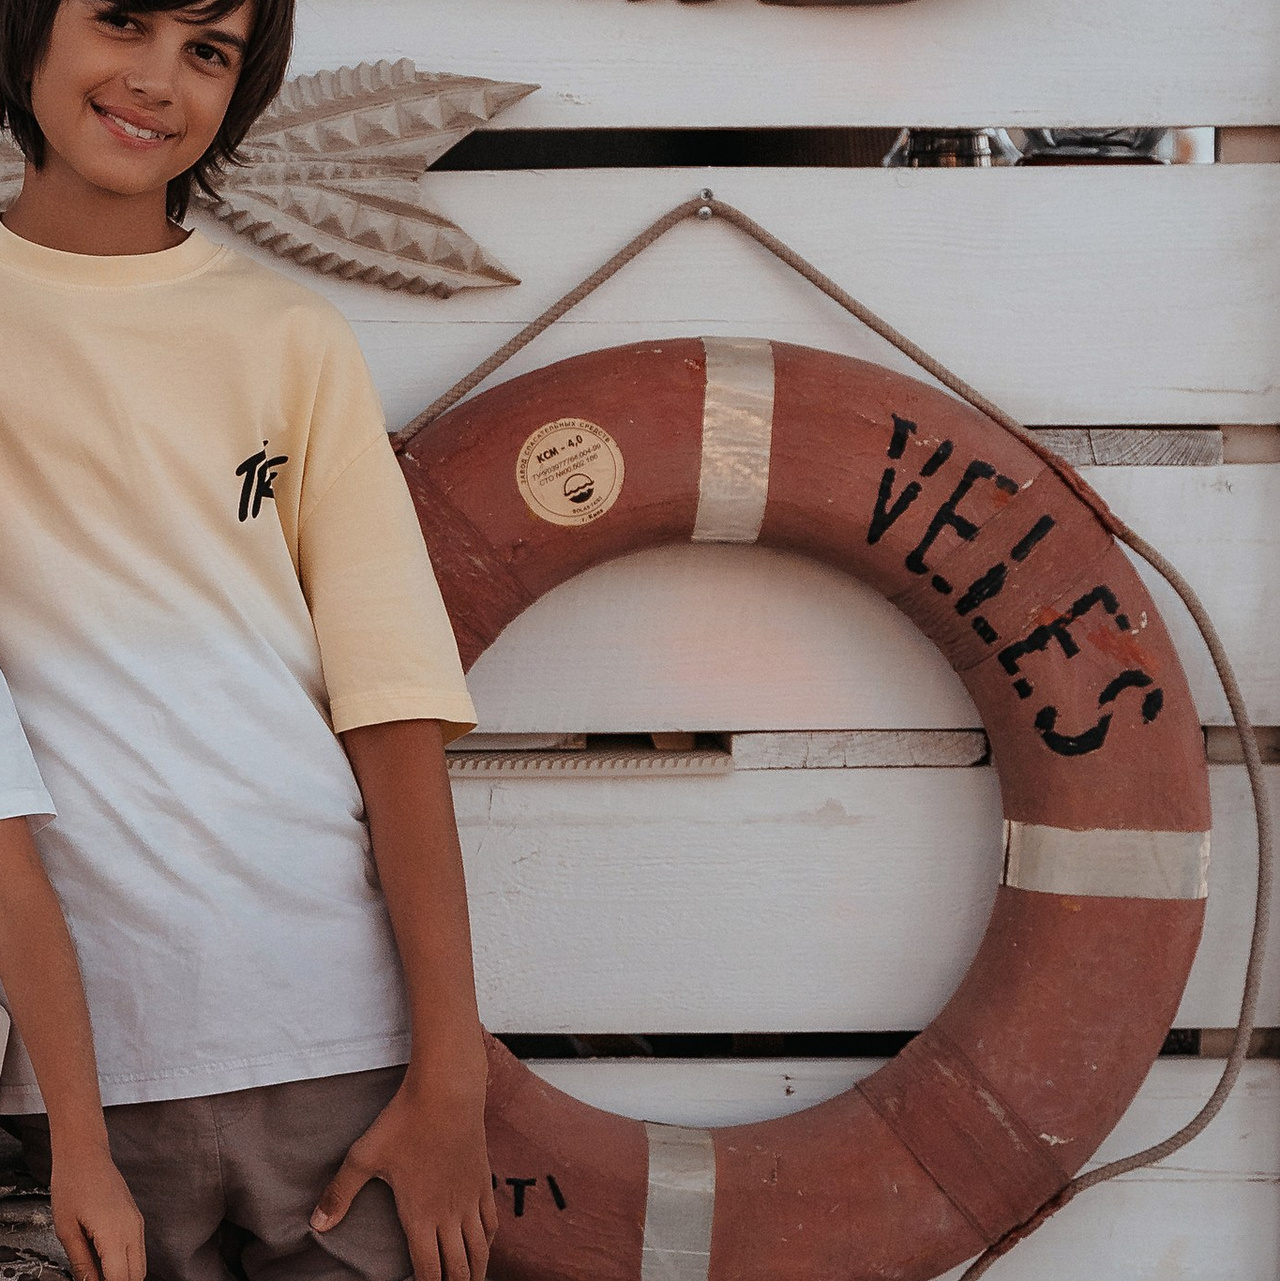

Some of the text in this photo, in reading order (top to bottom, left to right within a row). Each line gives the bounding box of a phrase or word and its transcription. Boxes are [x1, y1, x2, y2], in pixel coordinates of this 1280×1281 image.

[520, 421, 611, 485] ЗАВОД СПАСАТЕЛЬНЫХ СРЕДСТВ
[536, 446, 560, 464] КСМ
[567, 434, 583, 448] 4,0
[866, 412, 1164, 757] VELES
